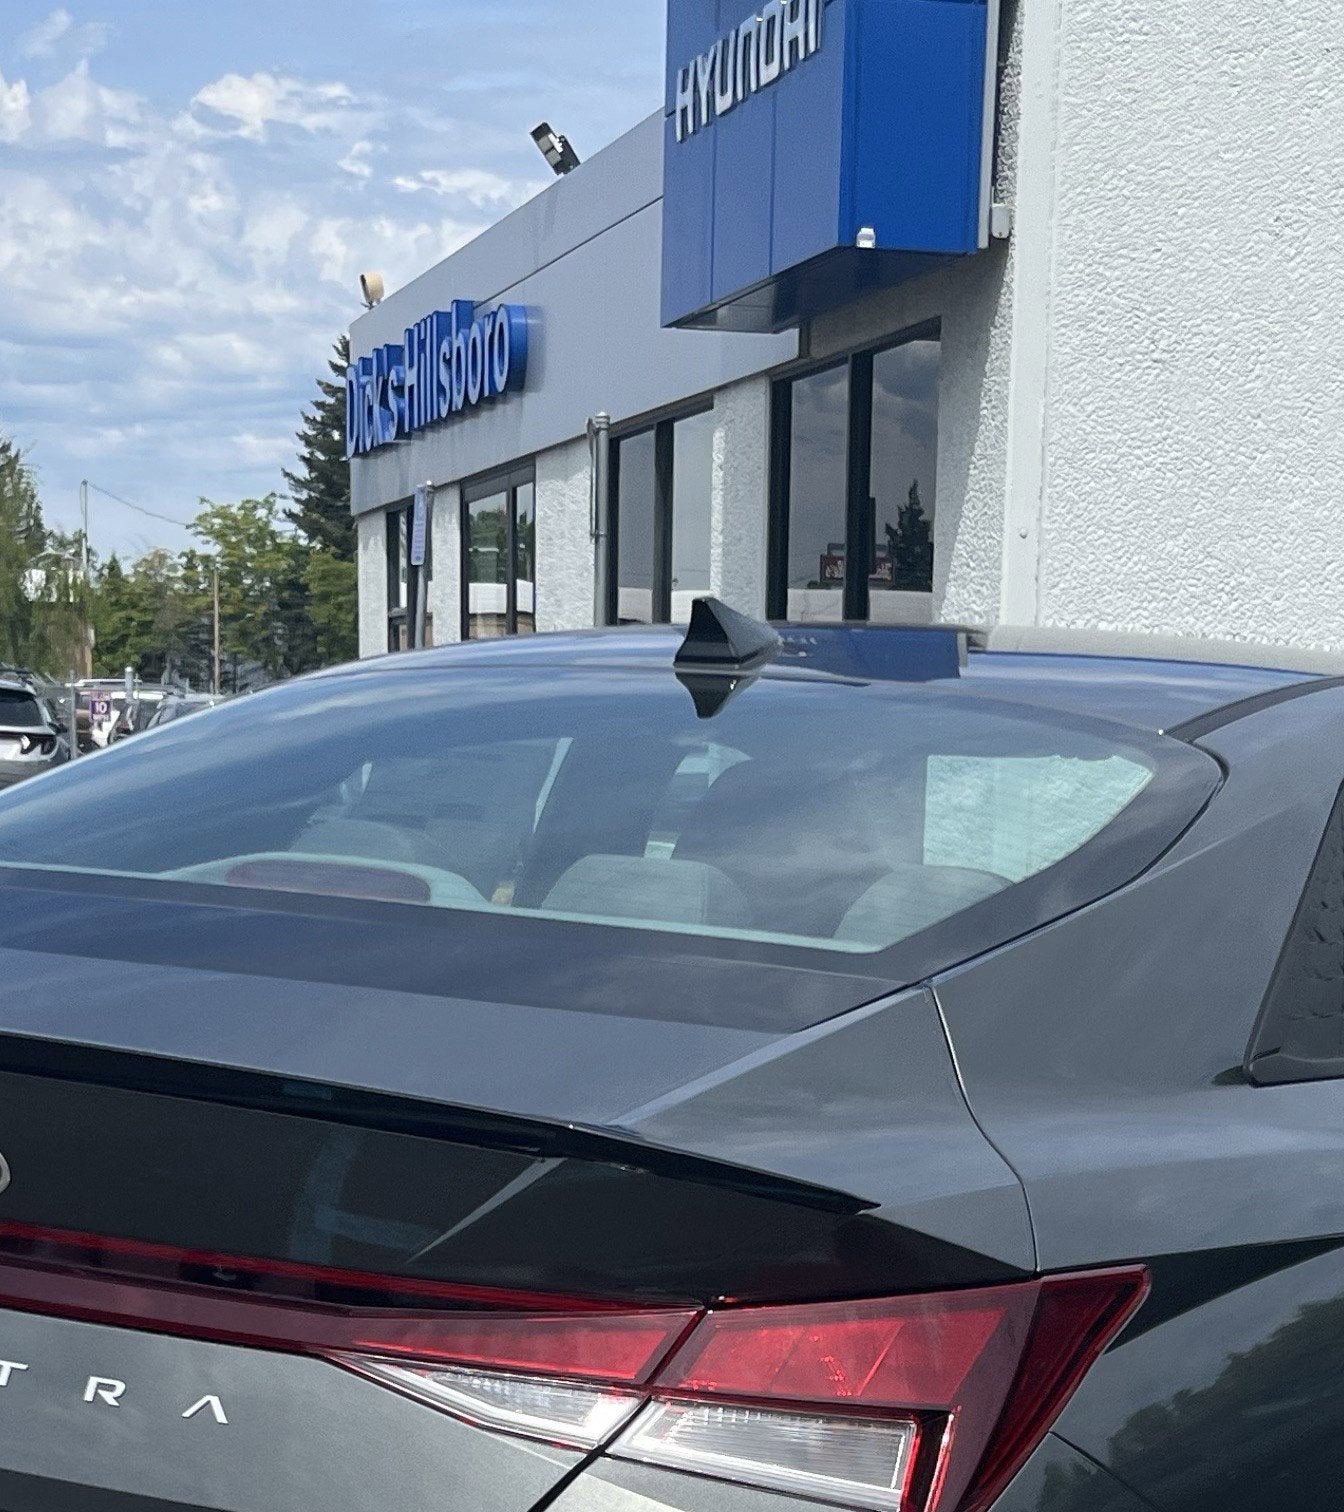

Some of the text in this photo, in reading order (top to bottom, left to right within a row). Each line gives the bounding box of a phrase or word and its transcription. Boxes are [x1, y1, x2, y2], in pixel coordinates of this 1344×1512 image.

[676, 0, 819, 143] HYUNDAI
[346, 299, 512, 458] Dick's Hillsboro
